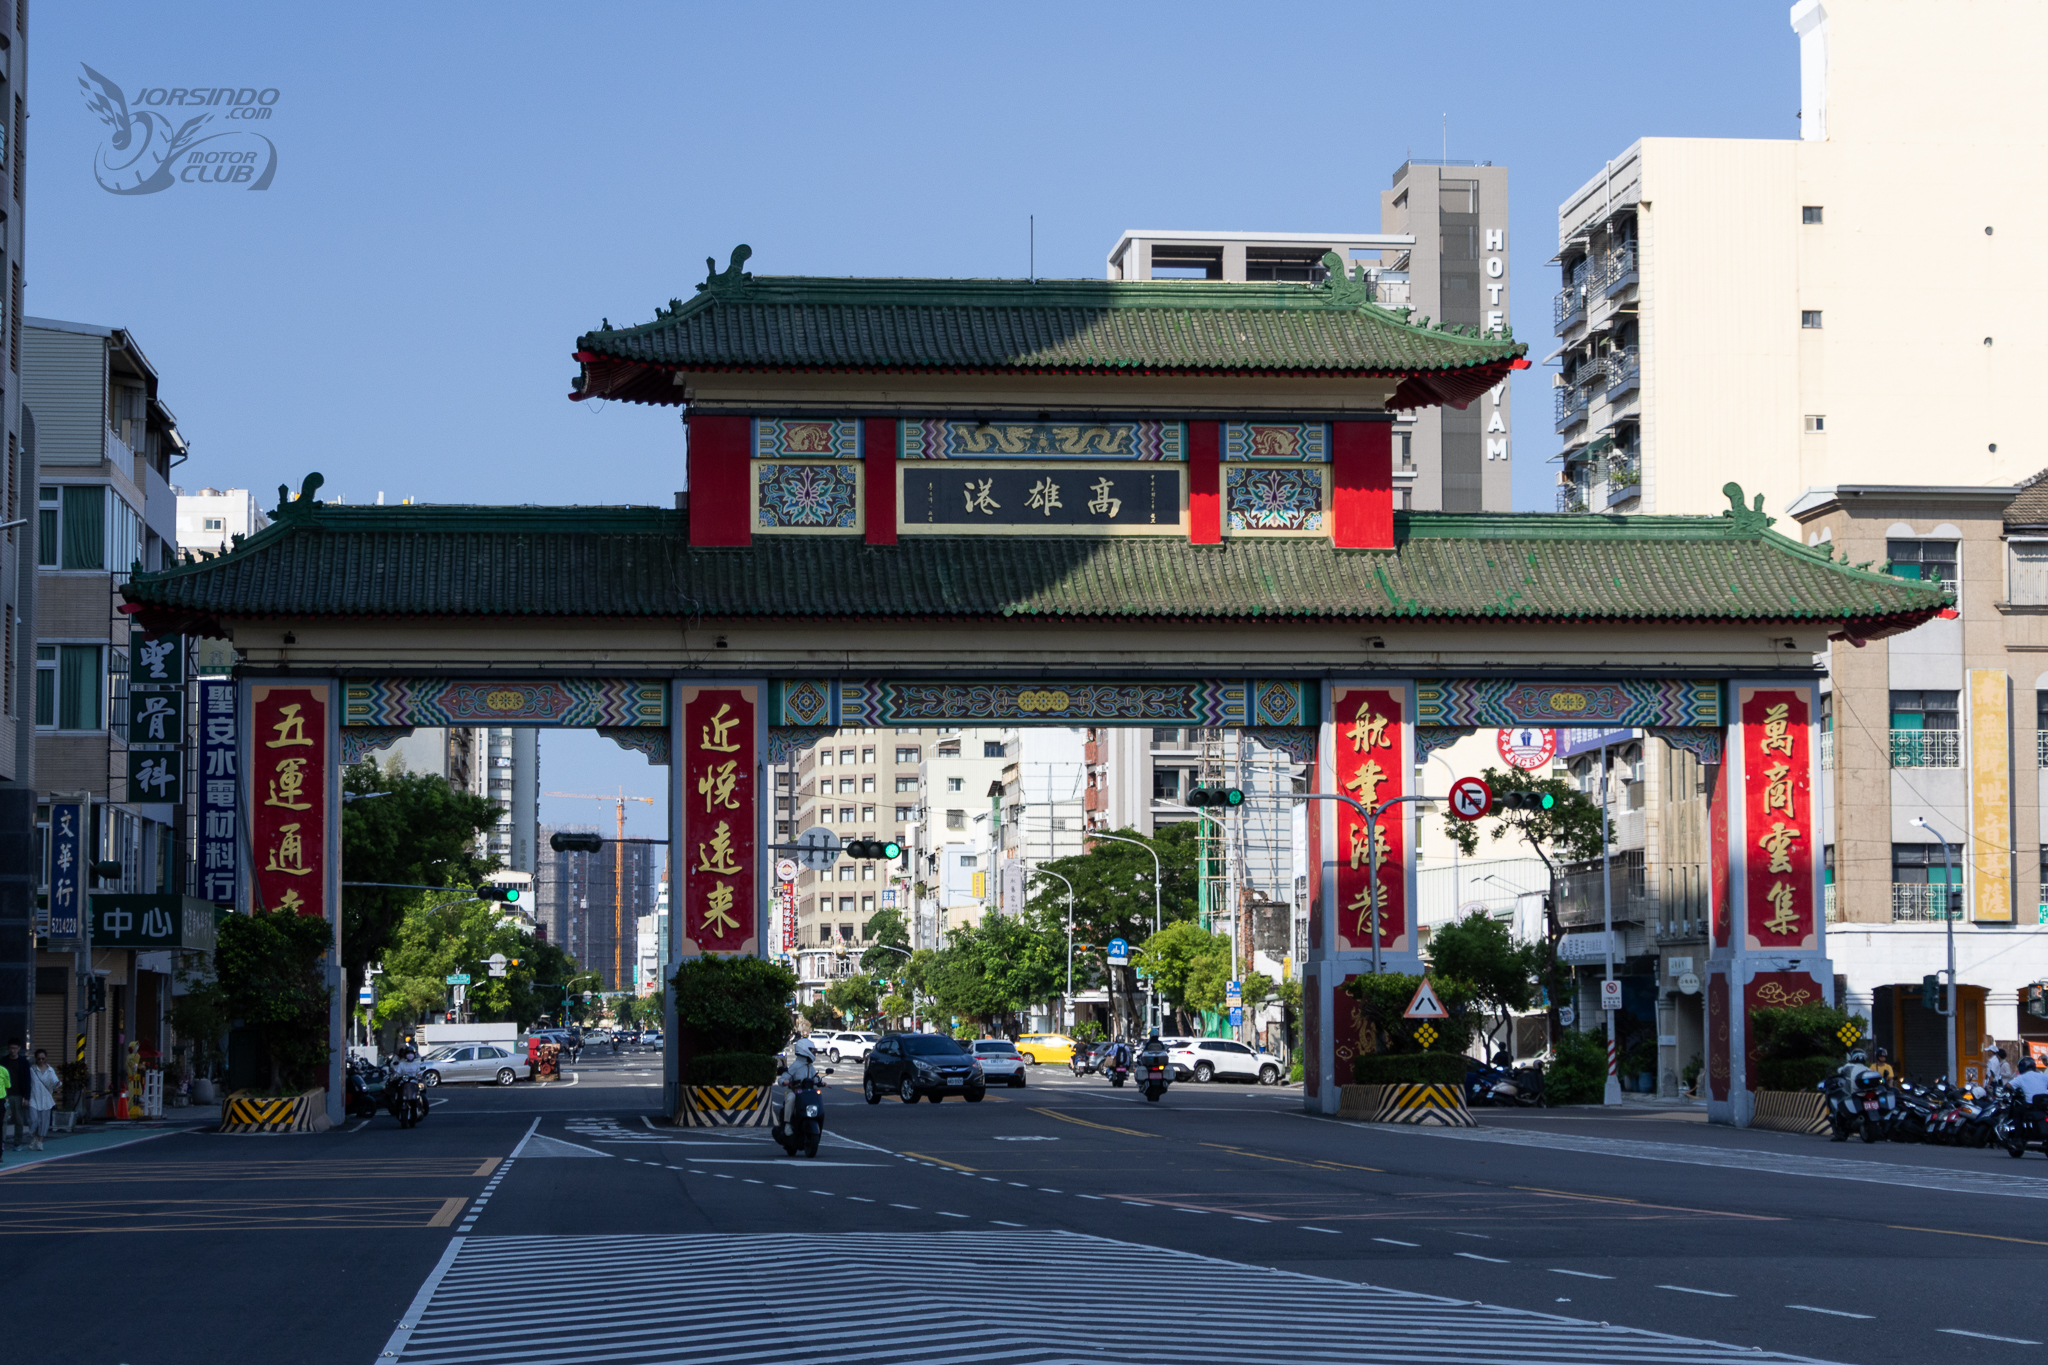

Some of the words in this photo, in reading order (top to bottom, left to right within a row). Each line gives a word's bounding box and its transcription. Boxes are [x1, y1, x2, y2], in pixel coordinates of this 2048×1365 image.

[1486, 228, 1503, 332] HOTE
[962, 476, 1123, 519] 高雄港
[134, 638, 177, 799] 聖骨科
[1510, 754, 1544, 767] NCSU
[205, 685, 236, 902] 聖安水電材料行
[1758, 703, 1801, 935] 萬商雲集
[55, 808, 75, 907] 文華行
[51, 917, 77, 934] 5214228
